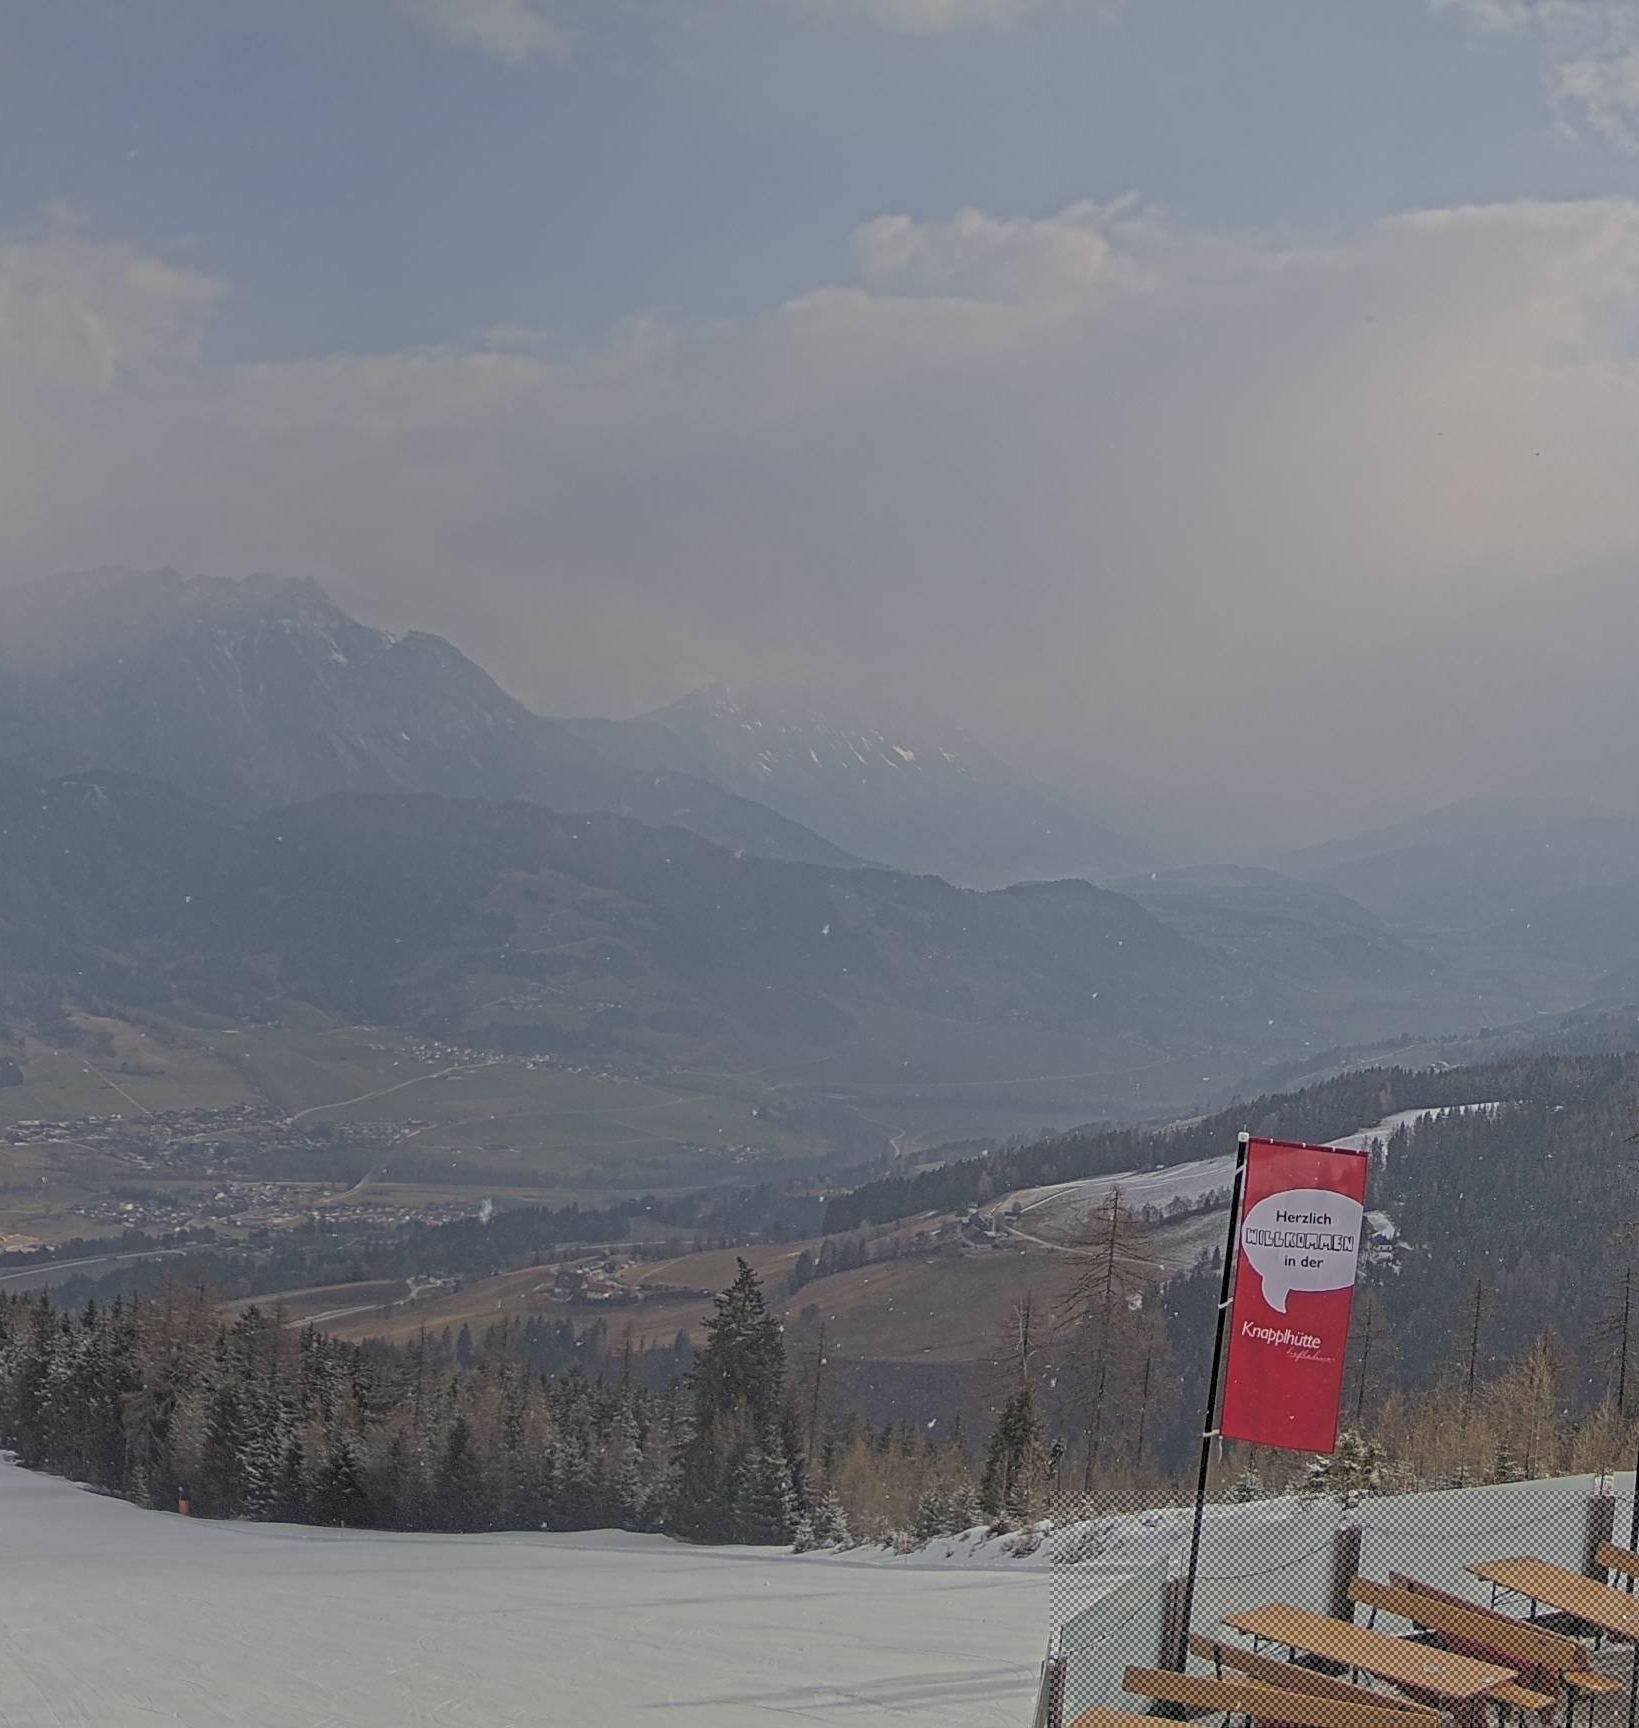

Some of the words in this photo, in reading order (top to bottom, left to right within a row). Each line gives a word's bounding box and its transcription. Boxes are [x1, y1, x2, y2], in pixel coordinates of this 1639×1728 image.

[1276, 1210, 1332, 1225] Herzlich
[1245, 1227, 1354, 1252] WILLKOMMEN
[1284, 1255, 1296, 1267] in
[1300, 1255, 1324, 1268] der
[1241, 1321, 1321, 1349] Knapplhütte
